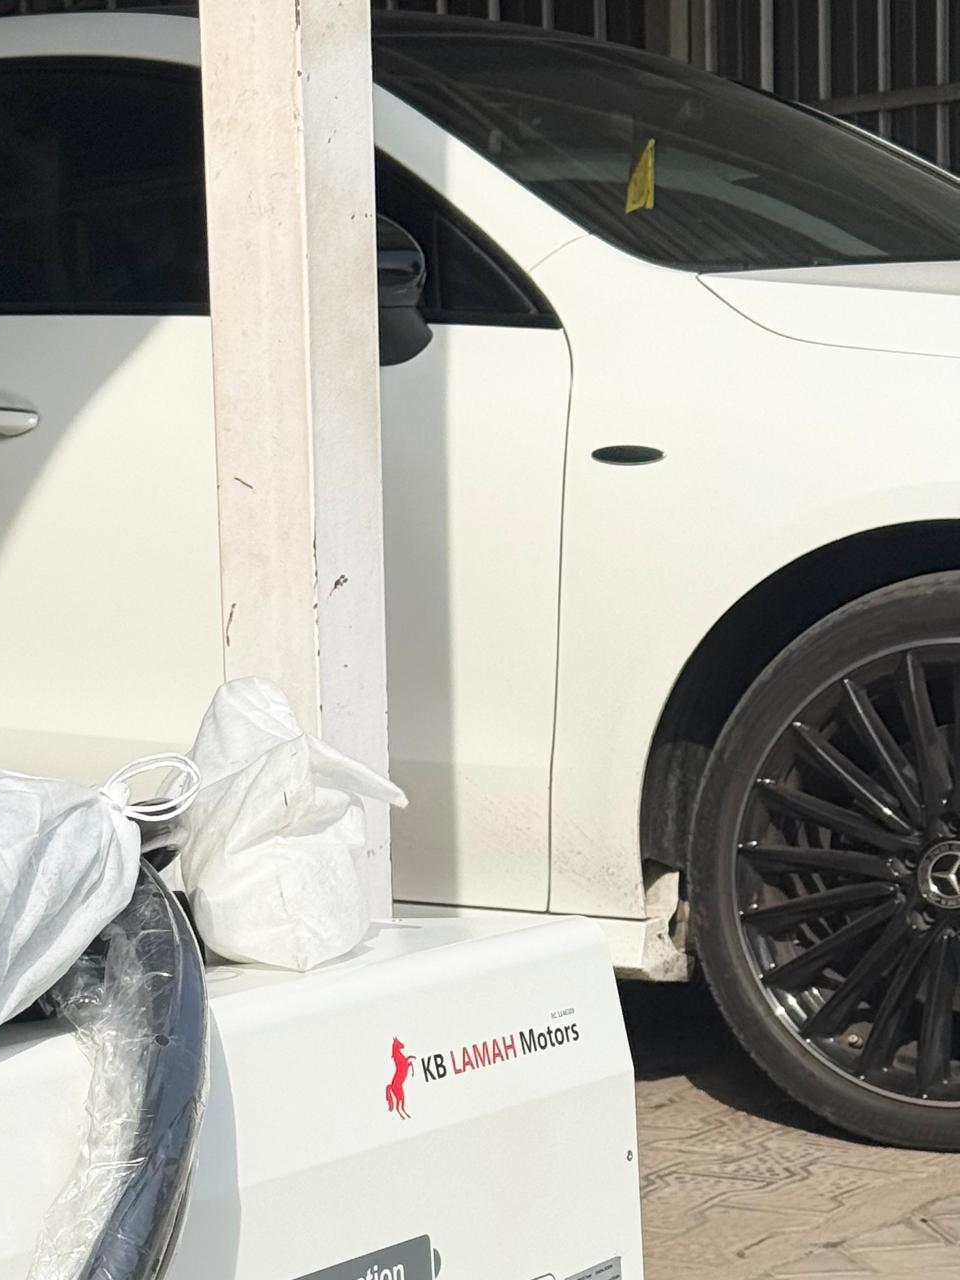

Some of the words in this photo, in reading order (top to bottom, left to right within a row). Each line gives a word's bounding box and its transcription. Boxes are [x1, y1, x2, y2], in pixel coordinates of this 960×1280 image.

[421, 1053, 447, 1083] KB
[450, 1034, 517, 1075] LAMAH
[519, 1022, 580, 1055] Motors
